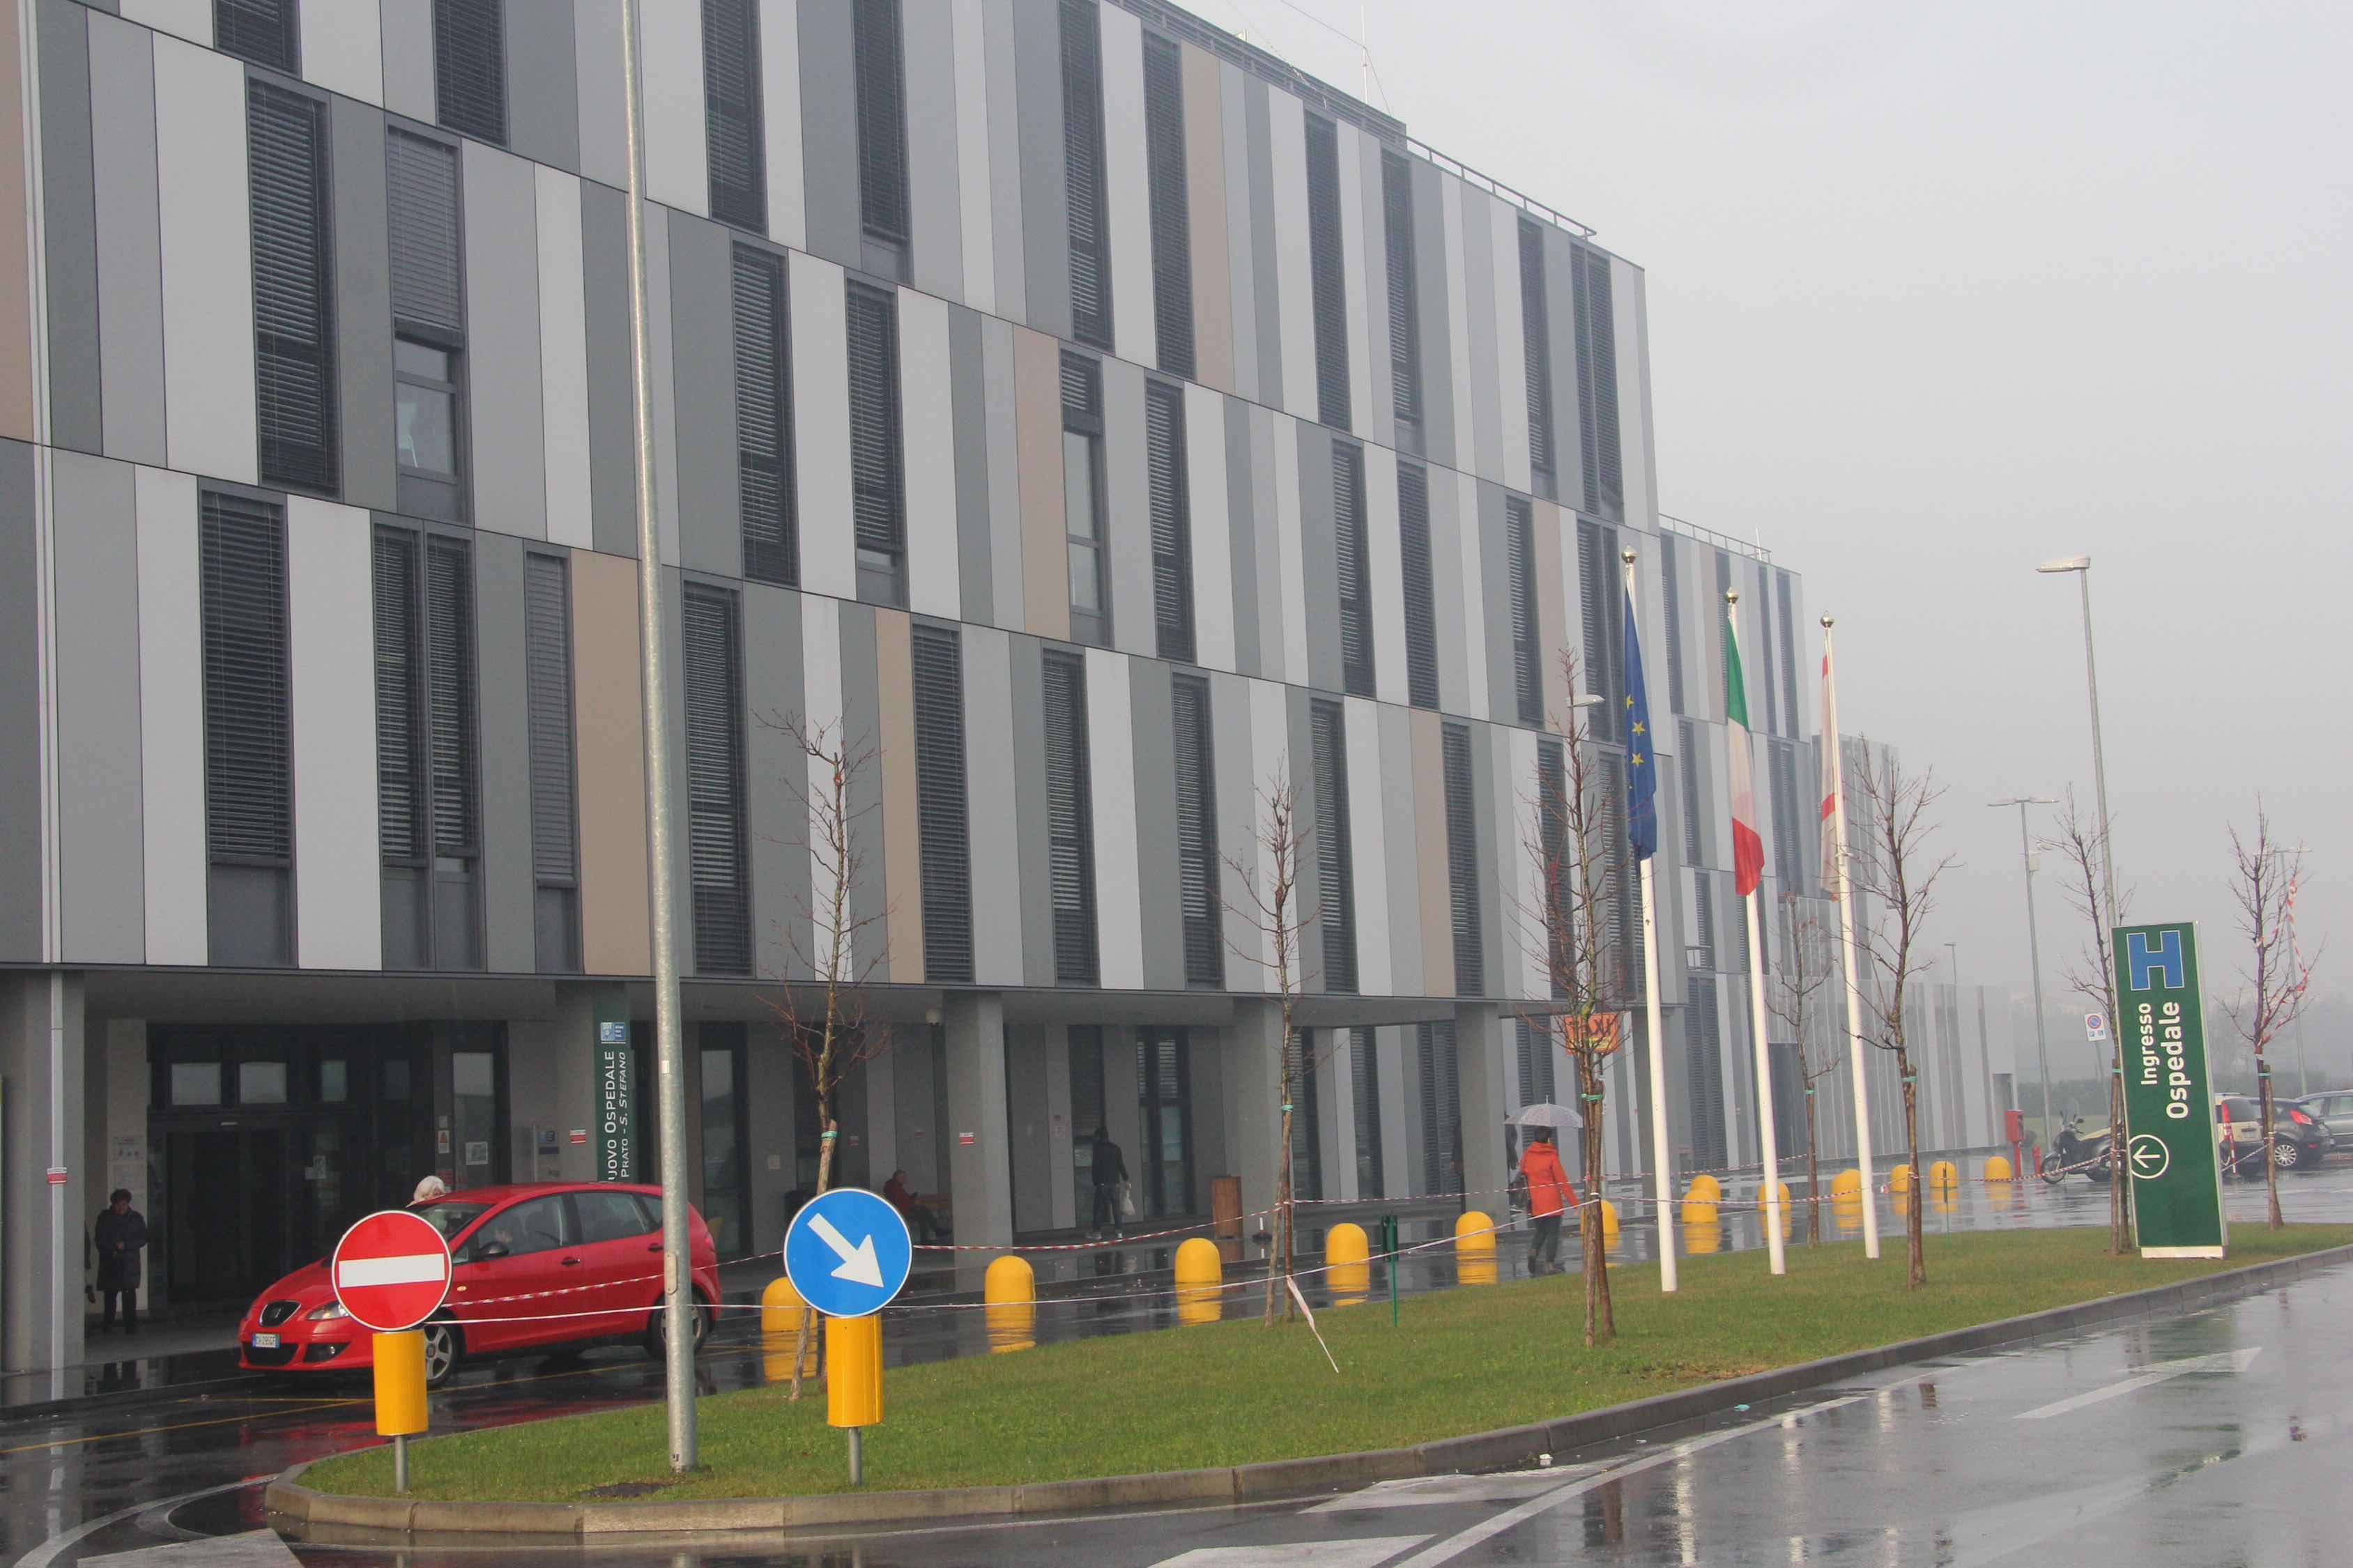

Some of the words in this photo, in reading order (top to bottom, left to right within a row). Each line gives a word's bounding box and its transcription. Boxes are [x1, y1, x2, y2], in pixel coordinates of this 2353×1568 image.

[2126, 930, 2184, 991] H
[2138, 1002, 2160, 1085] Ingresso
[2159, 1001, 2191, 1119] Ospedale
[604, 1051, 616, 1133] OSPEDALE
[619, 1052, 627, 1109] STEFANO
[607, 1139, 618, 1181] UOVO
